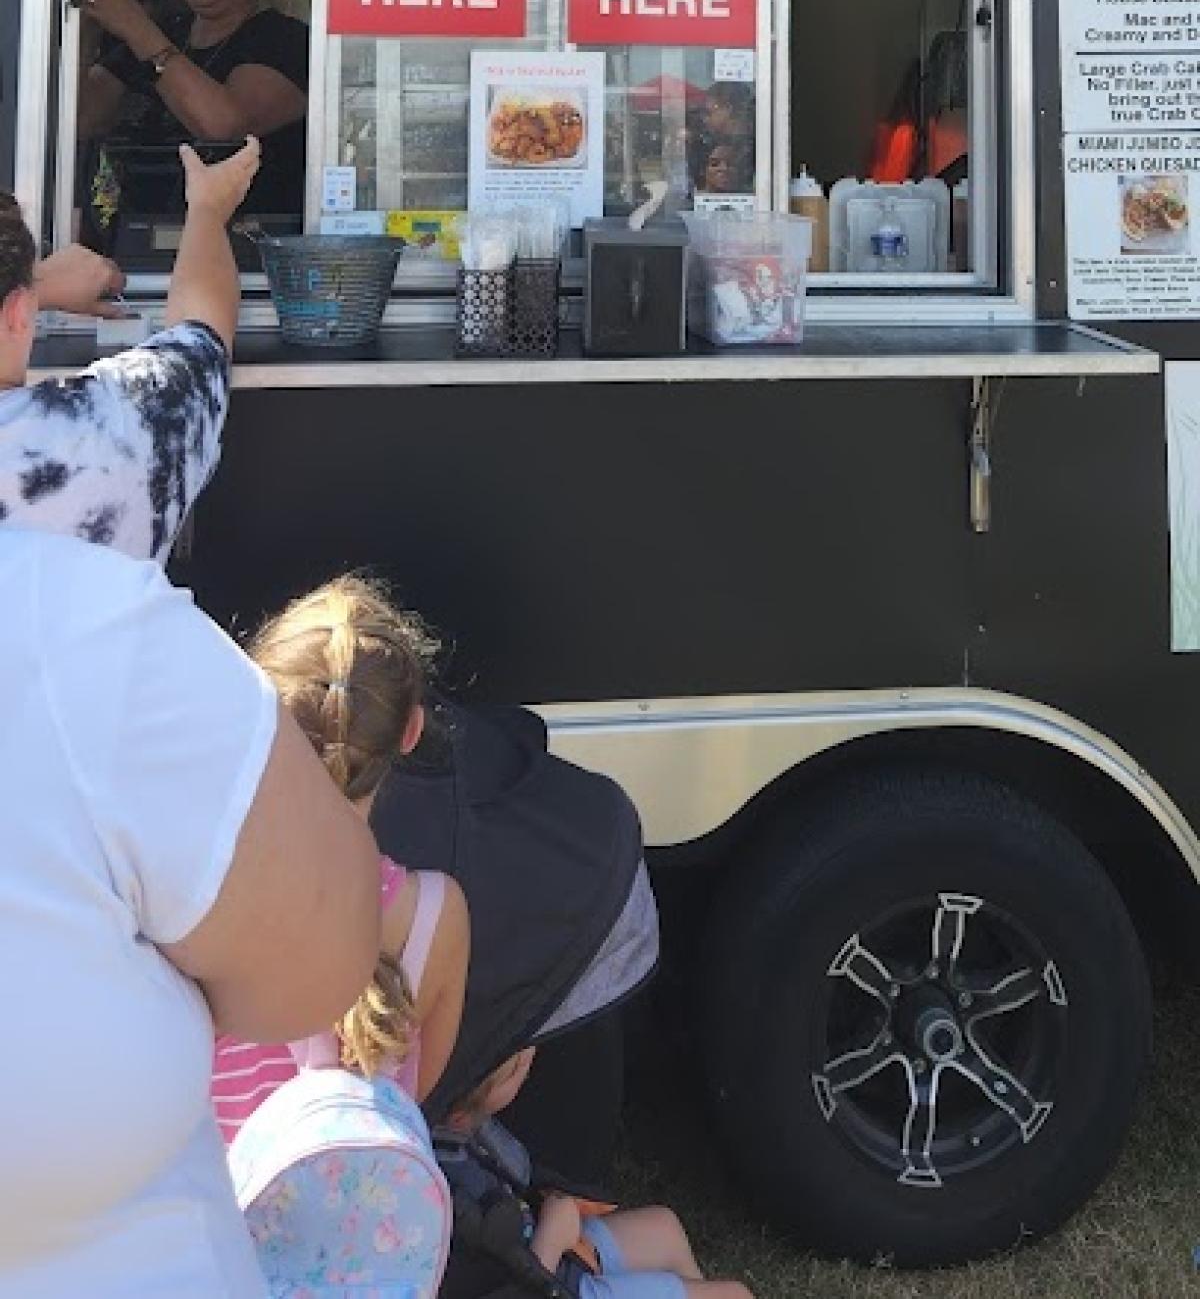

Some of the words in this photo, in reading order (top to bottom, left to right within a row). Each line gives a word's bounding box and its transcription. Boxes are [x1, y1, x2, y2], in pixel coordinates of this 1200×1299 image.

[1124, 13, 1158, 26] Mac
[1161, 12, 1192, 26] and
[1084, 27, 1149, 43] Creamy
[1152, 28, 1182, 42] and
[1079, 62, 1127, 78] Large
[1132, 60, 1170, 76] Crab
[1088, 78, 1110, 91] No
[1108, 93, 1151, 108] bring
[1155, 93, 1181, 105] out
[1111, 110, 1142, 122] true
[1147, 108, 1186, 121] Crab
[1067, 158, 1137, 173] CHICKEN
